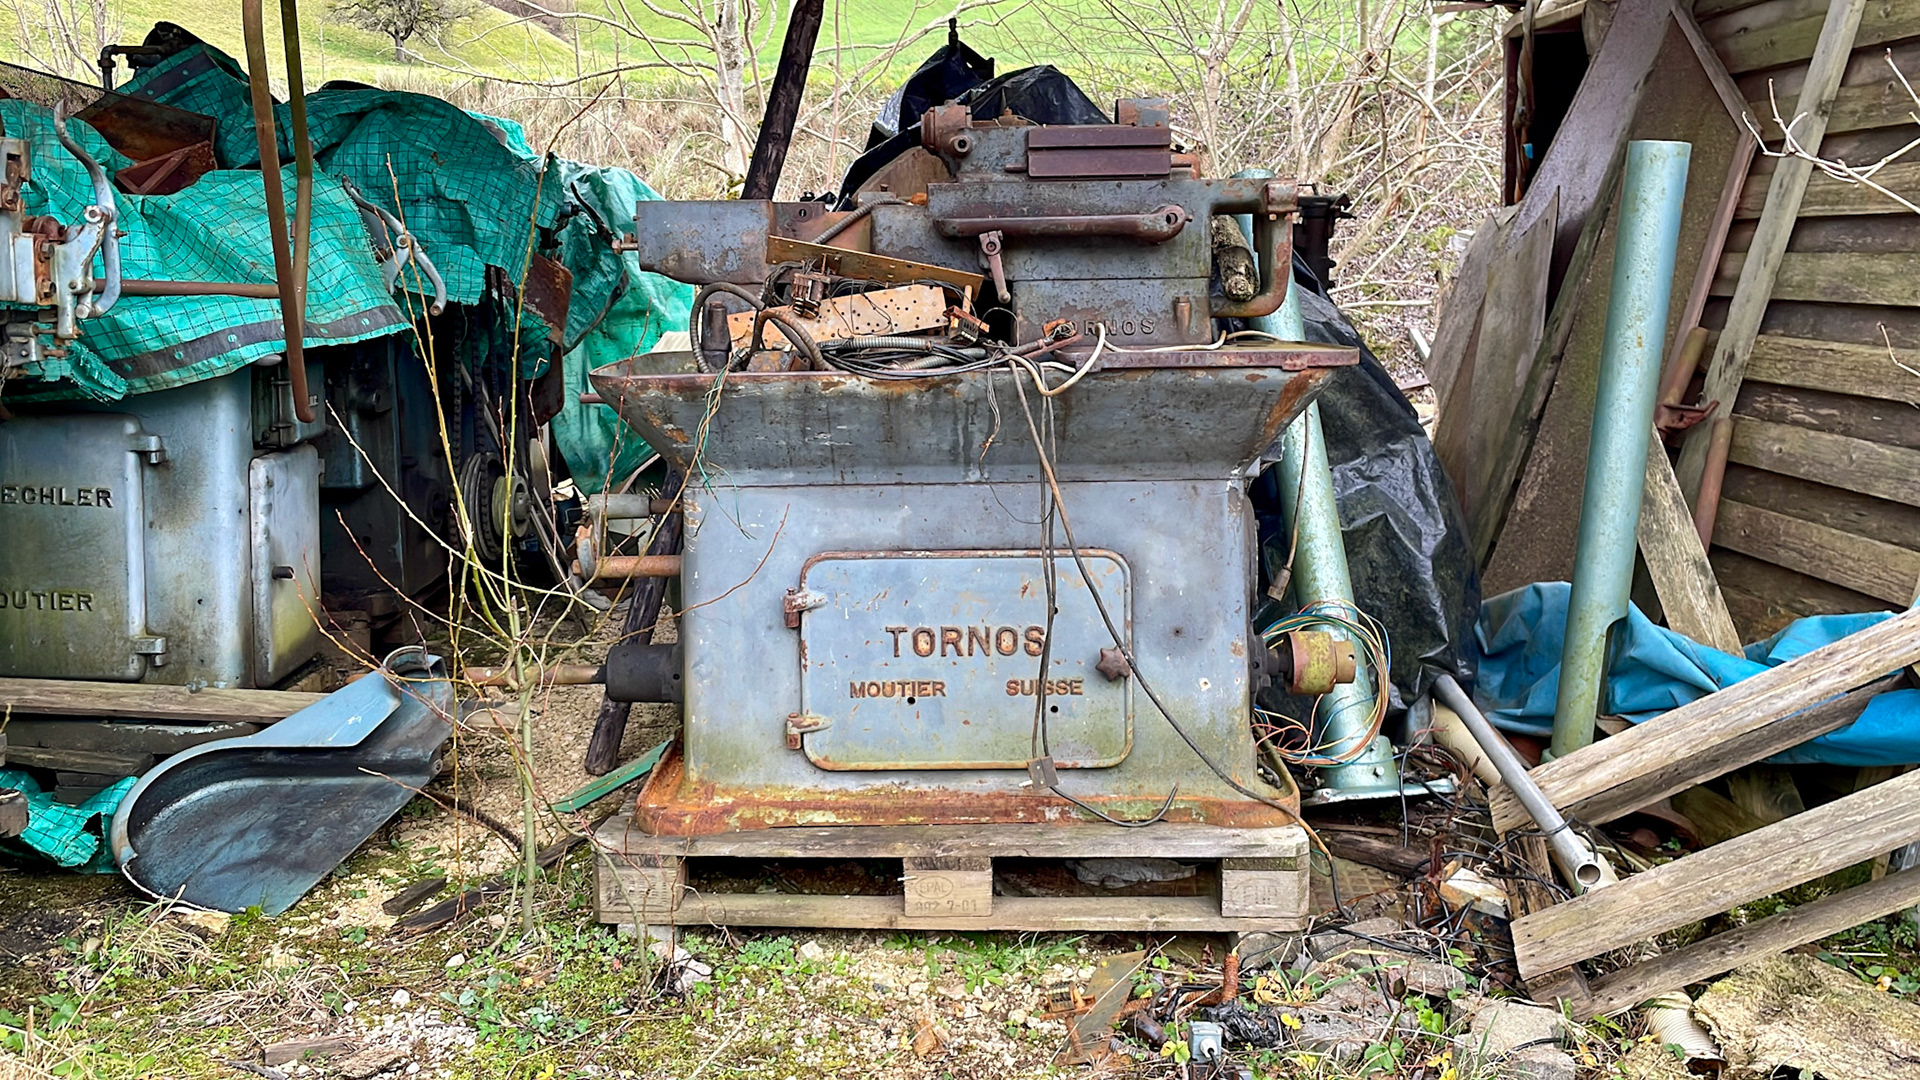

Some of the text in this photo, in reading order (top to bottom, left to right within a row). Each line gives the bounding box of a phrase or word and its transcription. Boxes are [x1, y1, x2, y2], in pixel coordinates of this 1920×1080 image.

[1069, 318, 1155, 337] RNOS
[1, 485, 114, 508] ECHLER
[885, 625, 1045, 657] TORNOS
[849, 678, 1084, 698] MOUTIER SUISSE
[919, 881, 948, 893] EPAL
